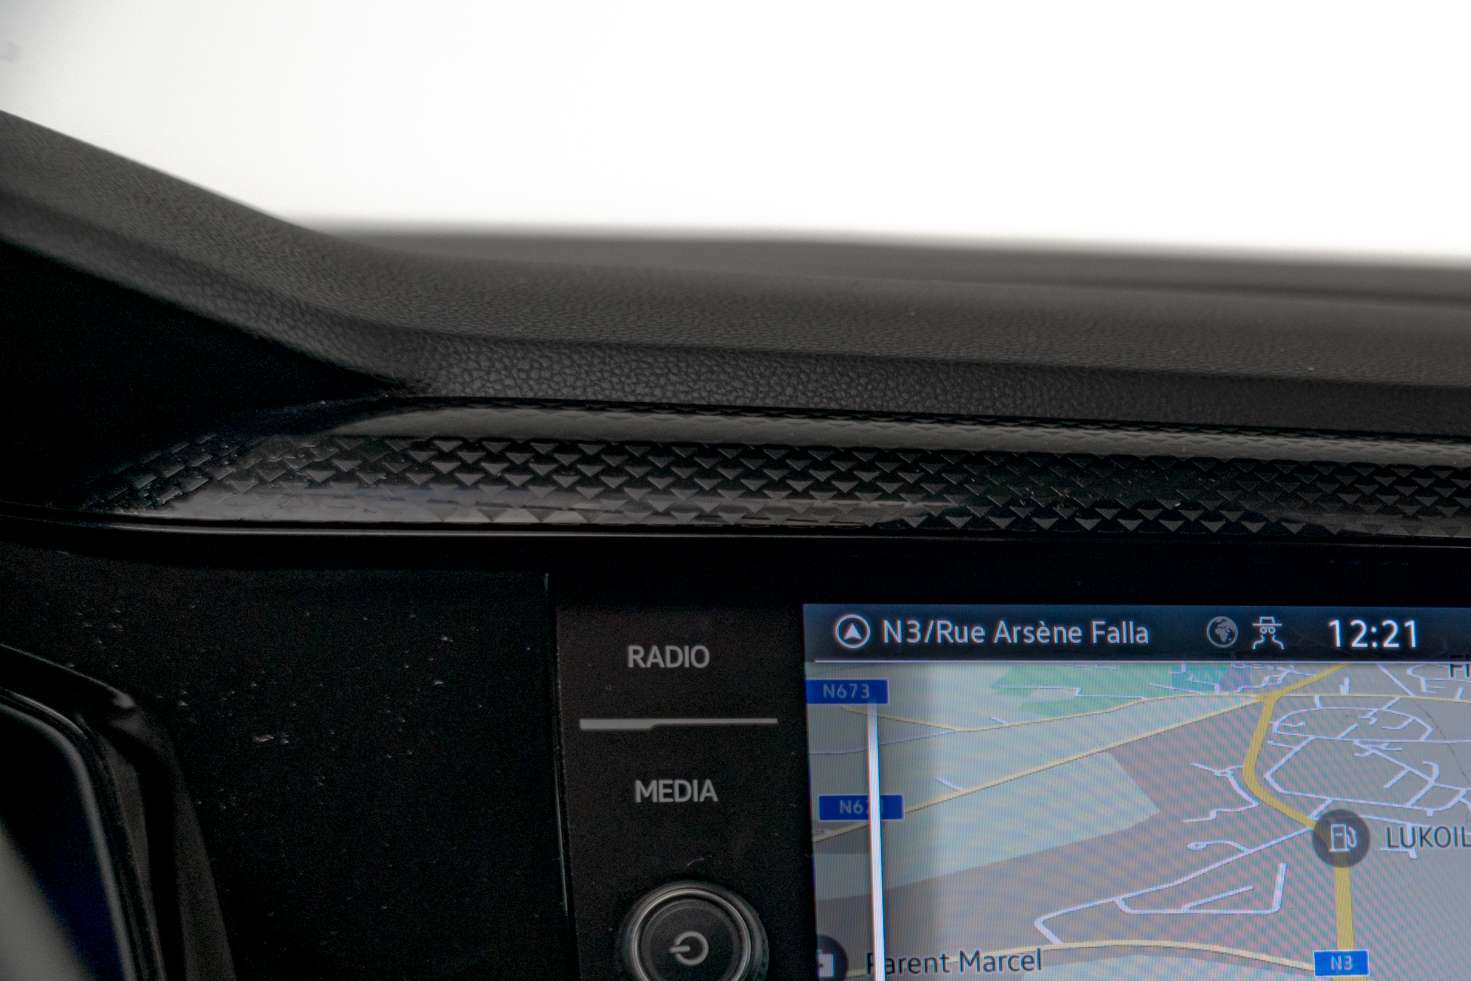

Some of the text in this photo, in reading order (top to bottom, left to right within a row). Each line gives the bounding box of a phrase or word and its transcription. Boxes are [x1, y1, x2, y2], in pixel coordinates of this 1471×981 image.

[883, 618, 1149, 644] N3/Rue Arsène Falla
[1328, 618, 1418, 648] 12:21
[627, 644, 710, 669] RADIO
[822, 683, 871, 699] N673
[634, 778, 719, 804] MEDIA
[958, 947, 1042, 973] Marcel
[1330, 954, 1353, 970] N3
